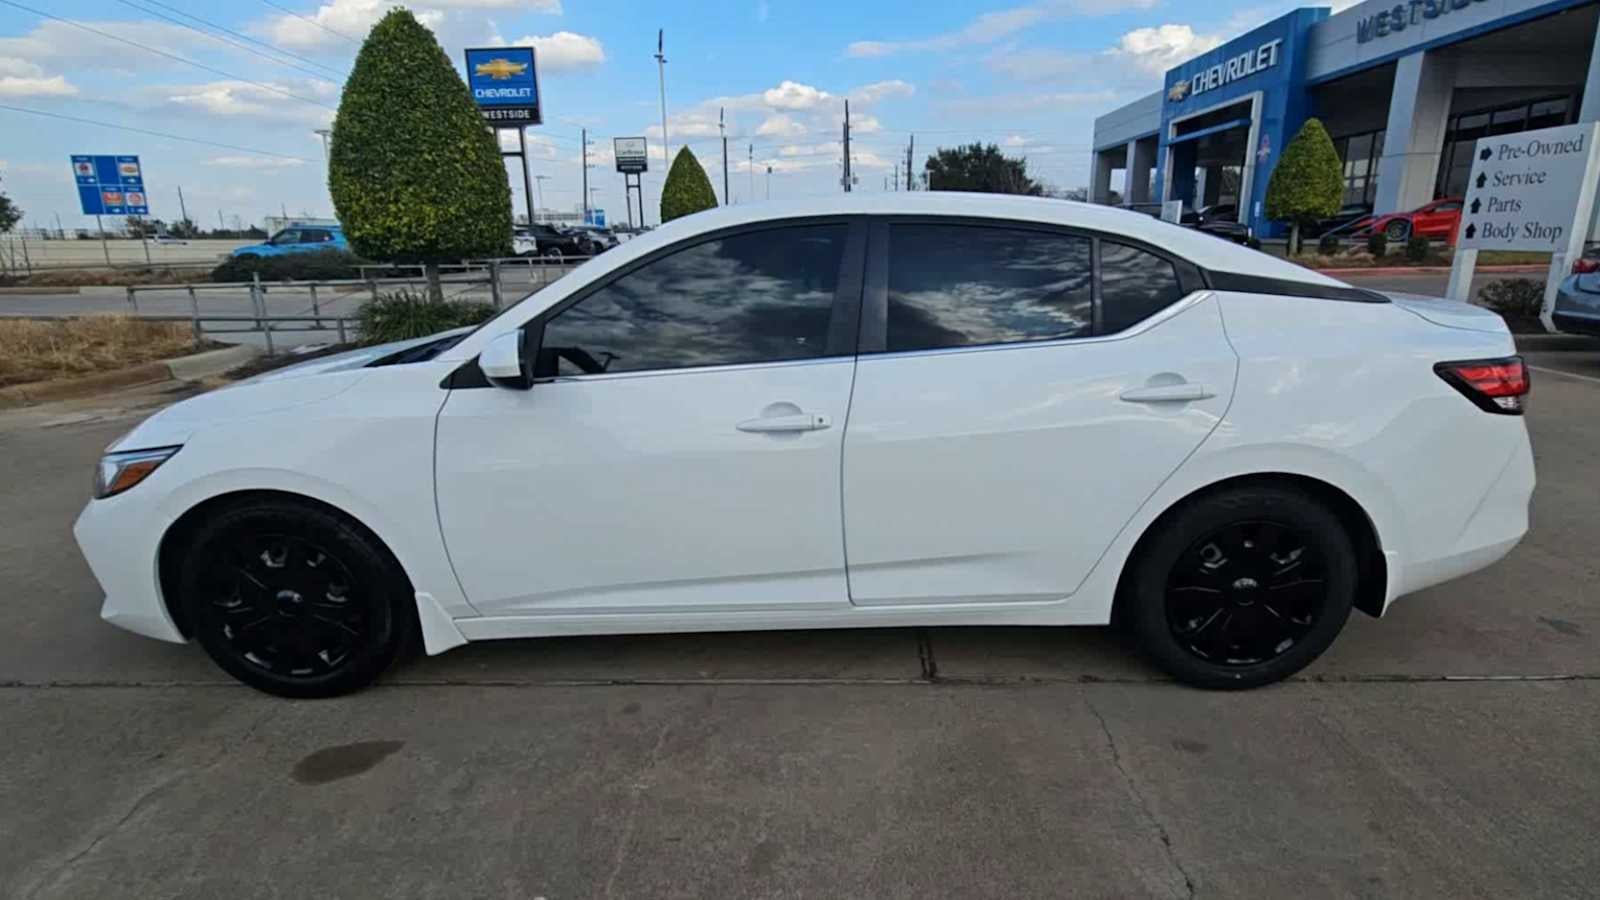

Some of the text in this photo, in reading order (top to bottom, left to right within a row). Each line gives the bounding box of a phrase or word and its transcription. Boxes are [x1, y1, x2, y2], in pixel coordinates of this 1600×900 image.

[1192, 38, 1283, 95] CHEVROLET
[475, 88, 531, 97] CHEVROLET
[1498, 133, 1584, 160] Pre-Owned
[1492, 167, 1547, 187] Service
[1487, 197, 1522, 213] Parts
[1481, 221, 1563, 243] Body Shop
